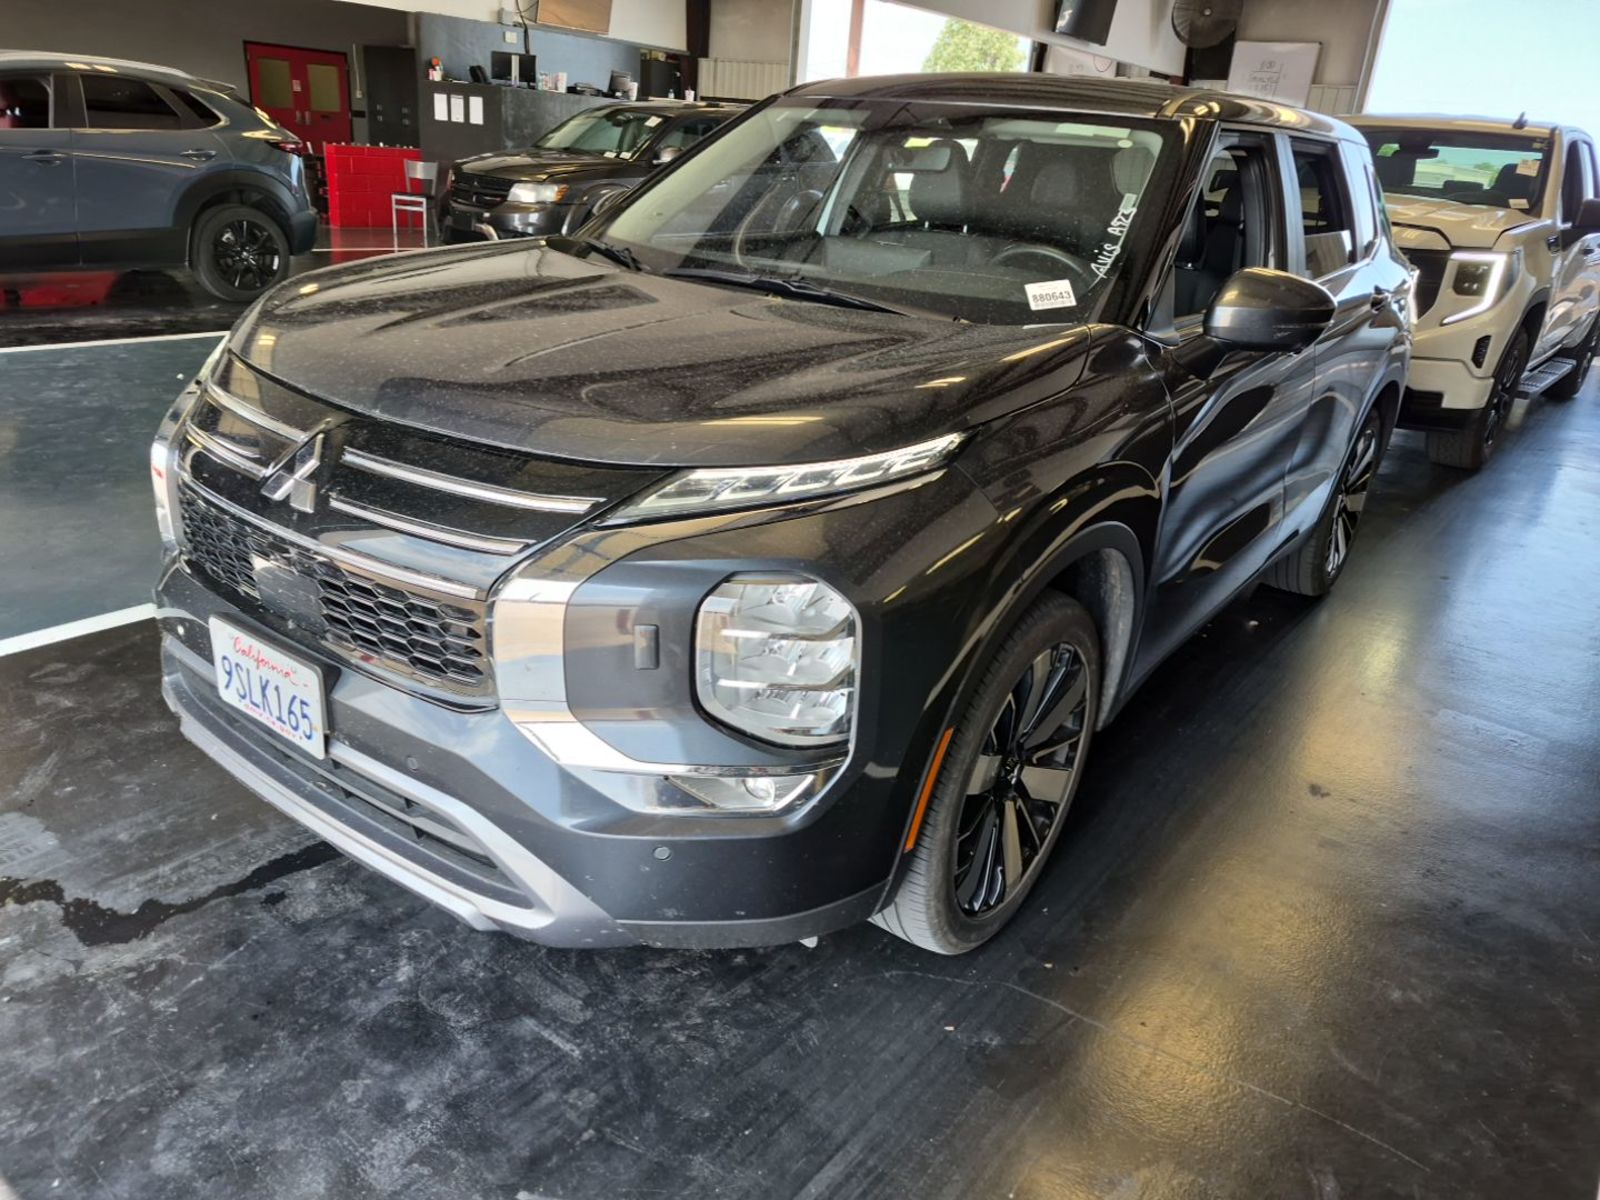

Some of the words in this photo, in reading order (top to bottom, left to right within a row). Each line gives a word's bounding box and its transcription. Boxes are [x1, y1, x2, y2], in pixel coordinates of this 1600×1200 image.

[1031, 290, 1071, 304] 880643
[233, 636, 296, 679] California
[221, 655, 313, 741] 9SLK165
